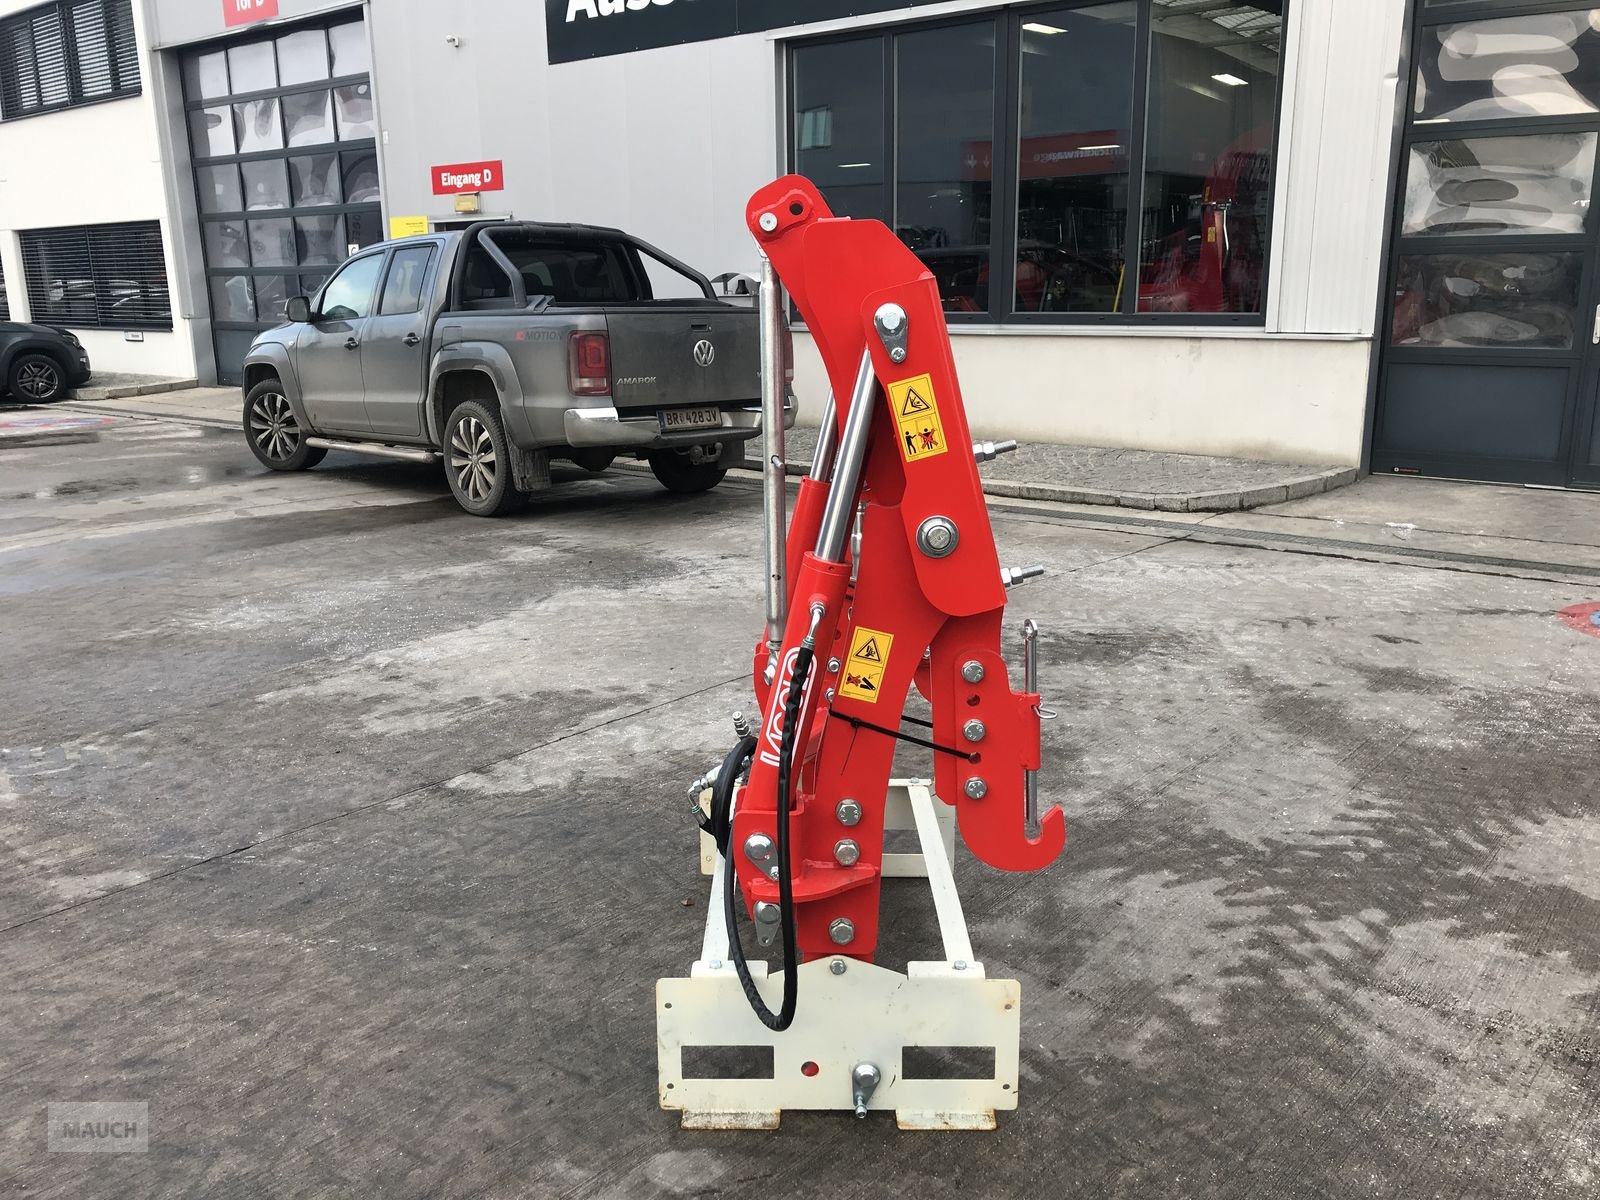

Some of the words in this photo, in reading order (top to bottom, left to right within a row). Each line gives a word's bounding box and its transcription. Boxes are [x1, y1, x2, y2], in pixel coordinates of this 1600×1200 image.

[441, 172, 481, 188] Eingang
[483, 169, 492, 183] D
[616, 376, 656, 385] AMAROK
[666, 412, 680, 426] BR
[685, 411, 704, 424] 428
[705, 409, 717, 422] JV
